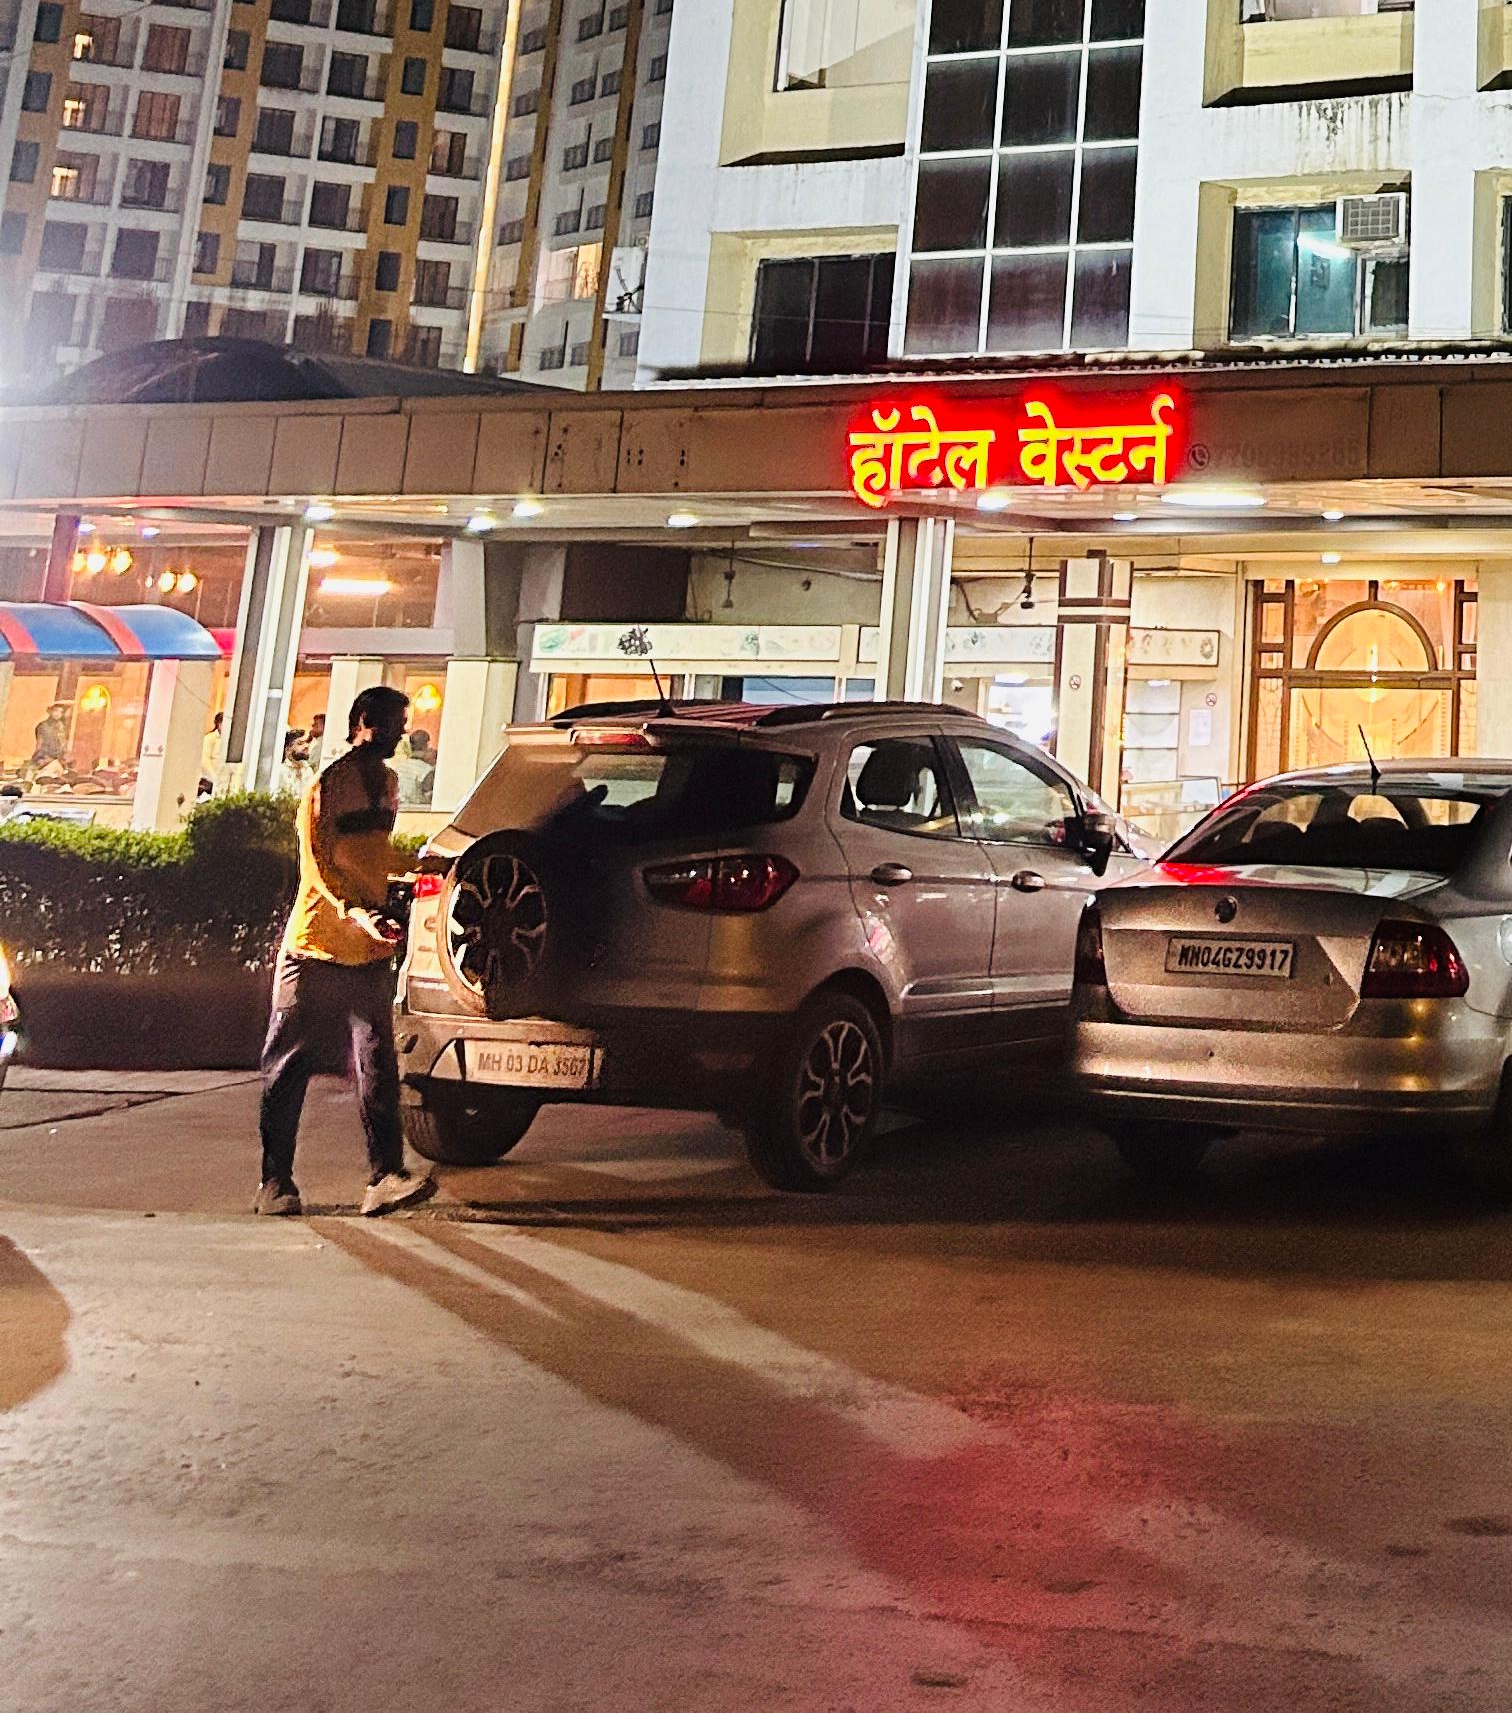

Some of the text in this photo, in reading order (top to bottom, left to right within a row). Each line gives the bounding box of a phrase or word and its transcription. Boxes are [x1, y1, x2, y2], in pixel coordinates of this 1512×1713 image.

[850, 393, 1174, 508] हॉटेल वेस्टर्न
[1178, 945, 1290, 971] MH04GZ9917
[478, 1053, 502, 1071] MH
[507, 1054, 523, 1072] 03
[528, 1055, 549, 1075] DA
